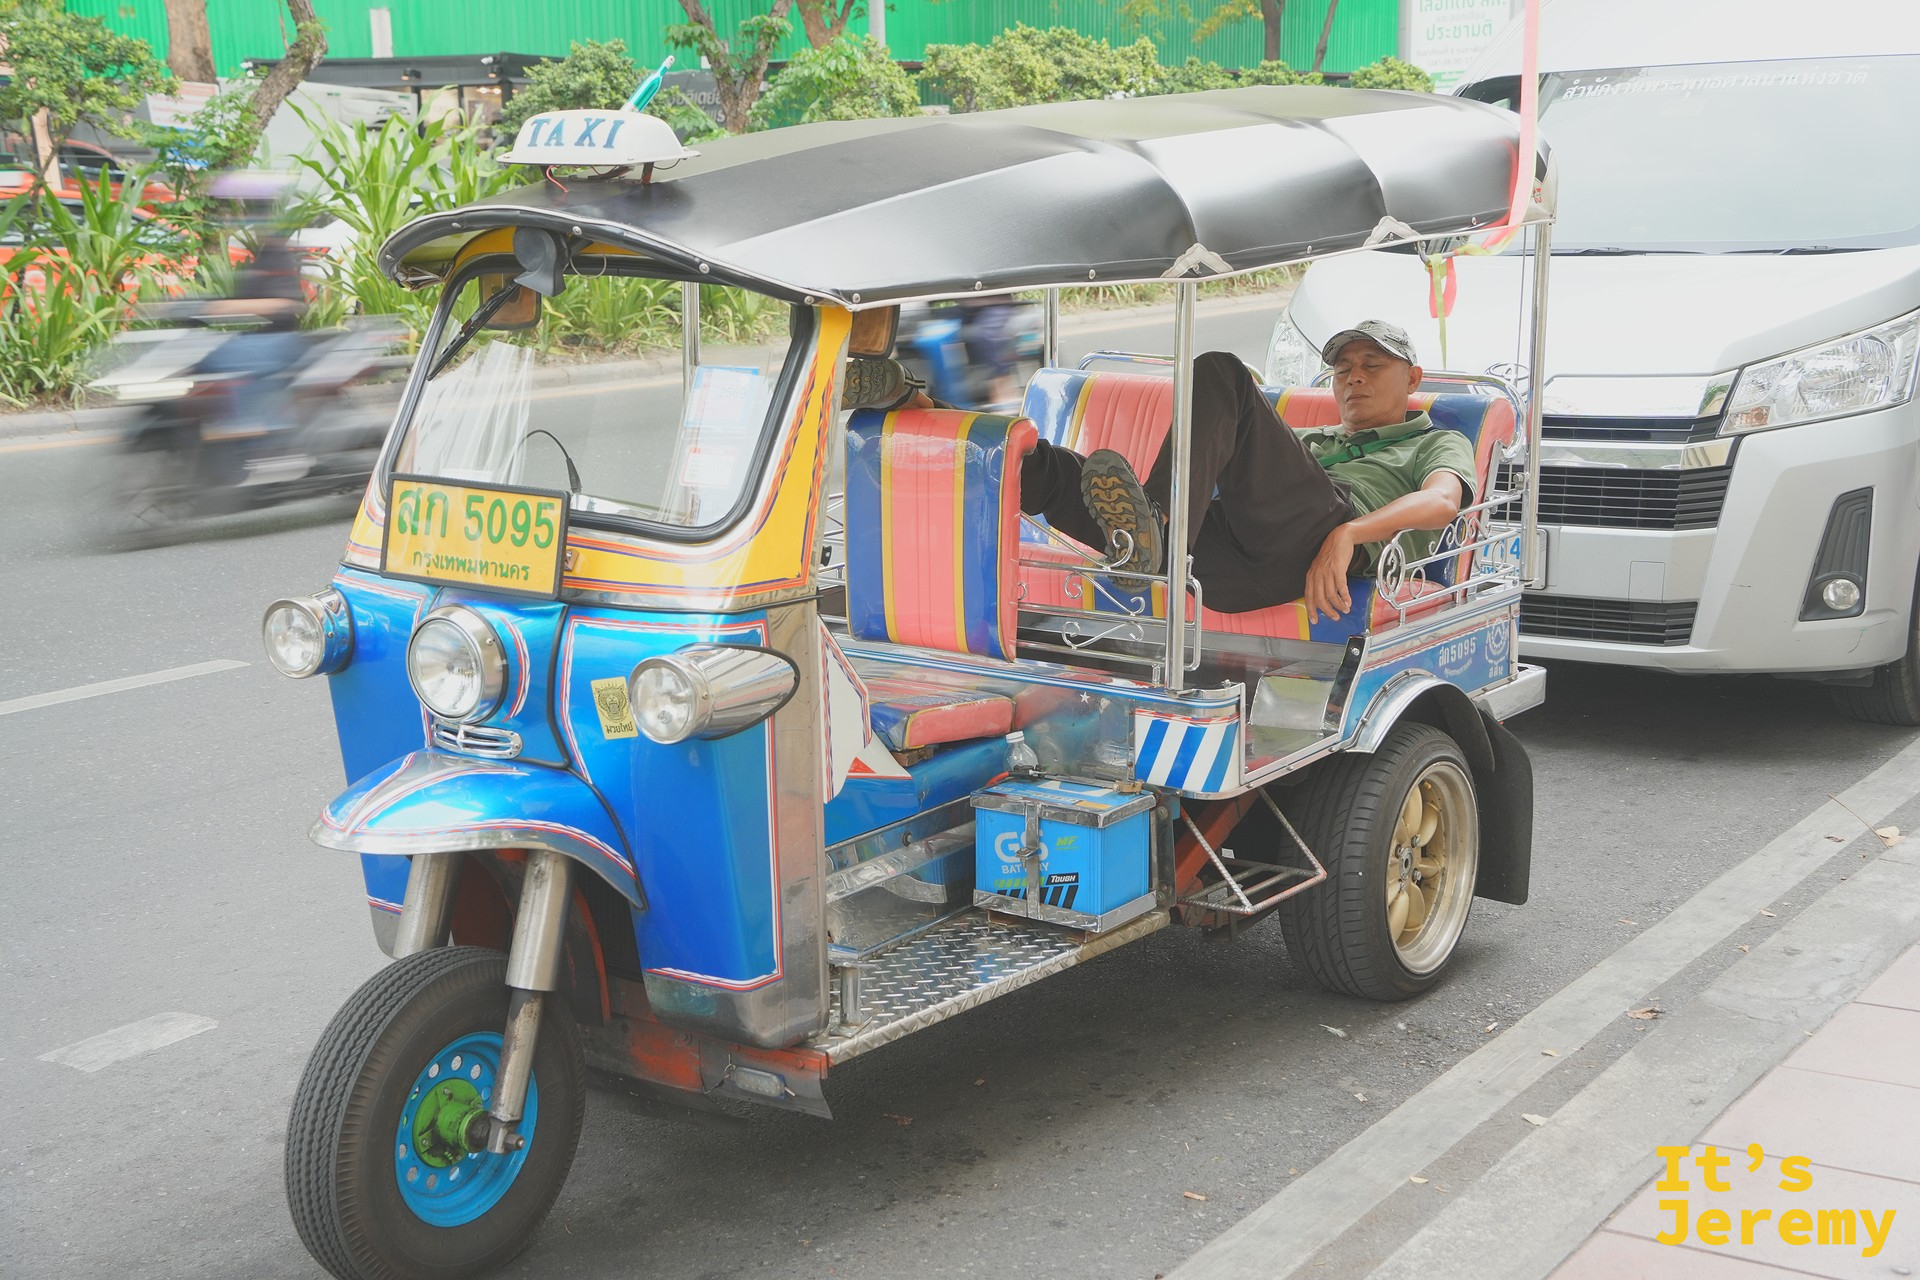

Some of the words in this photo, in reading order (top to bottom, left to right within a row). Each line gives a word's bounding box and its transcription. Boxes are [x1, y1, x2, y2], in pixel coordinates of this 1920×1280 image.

[1426, 19, 1493, 41] ประชามติ
[528, 117, 625, 148] TAXI
[397, 487, 449, 537] สก
[464, 494, 555, 548] 5095
[413, 551, 530, 582] กรุงเทพมหานคร
[605, 721, 633, 734] มวยไทย
[1056, 836, 1079, 847] MF
[1002, 862, 1049, 875] BATY
[1051, 875, 1076, 883] TOUGH
